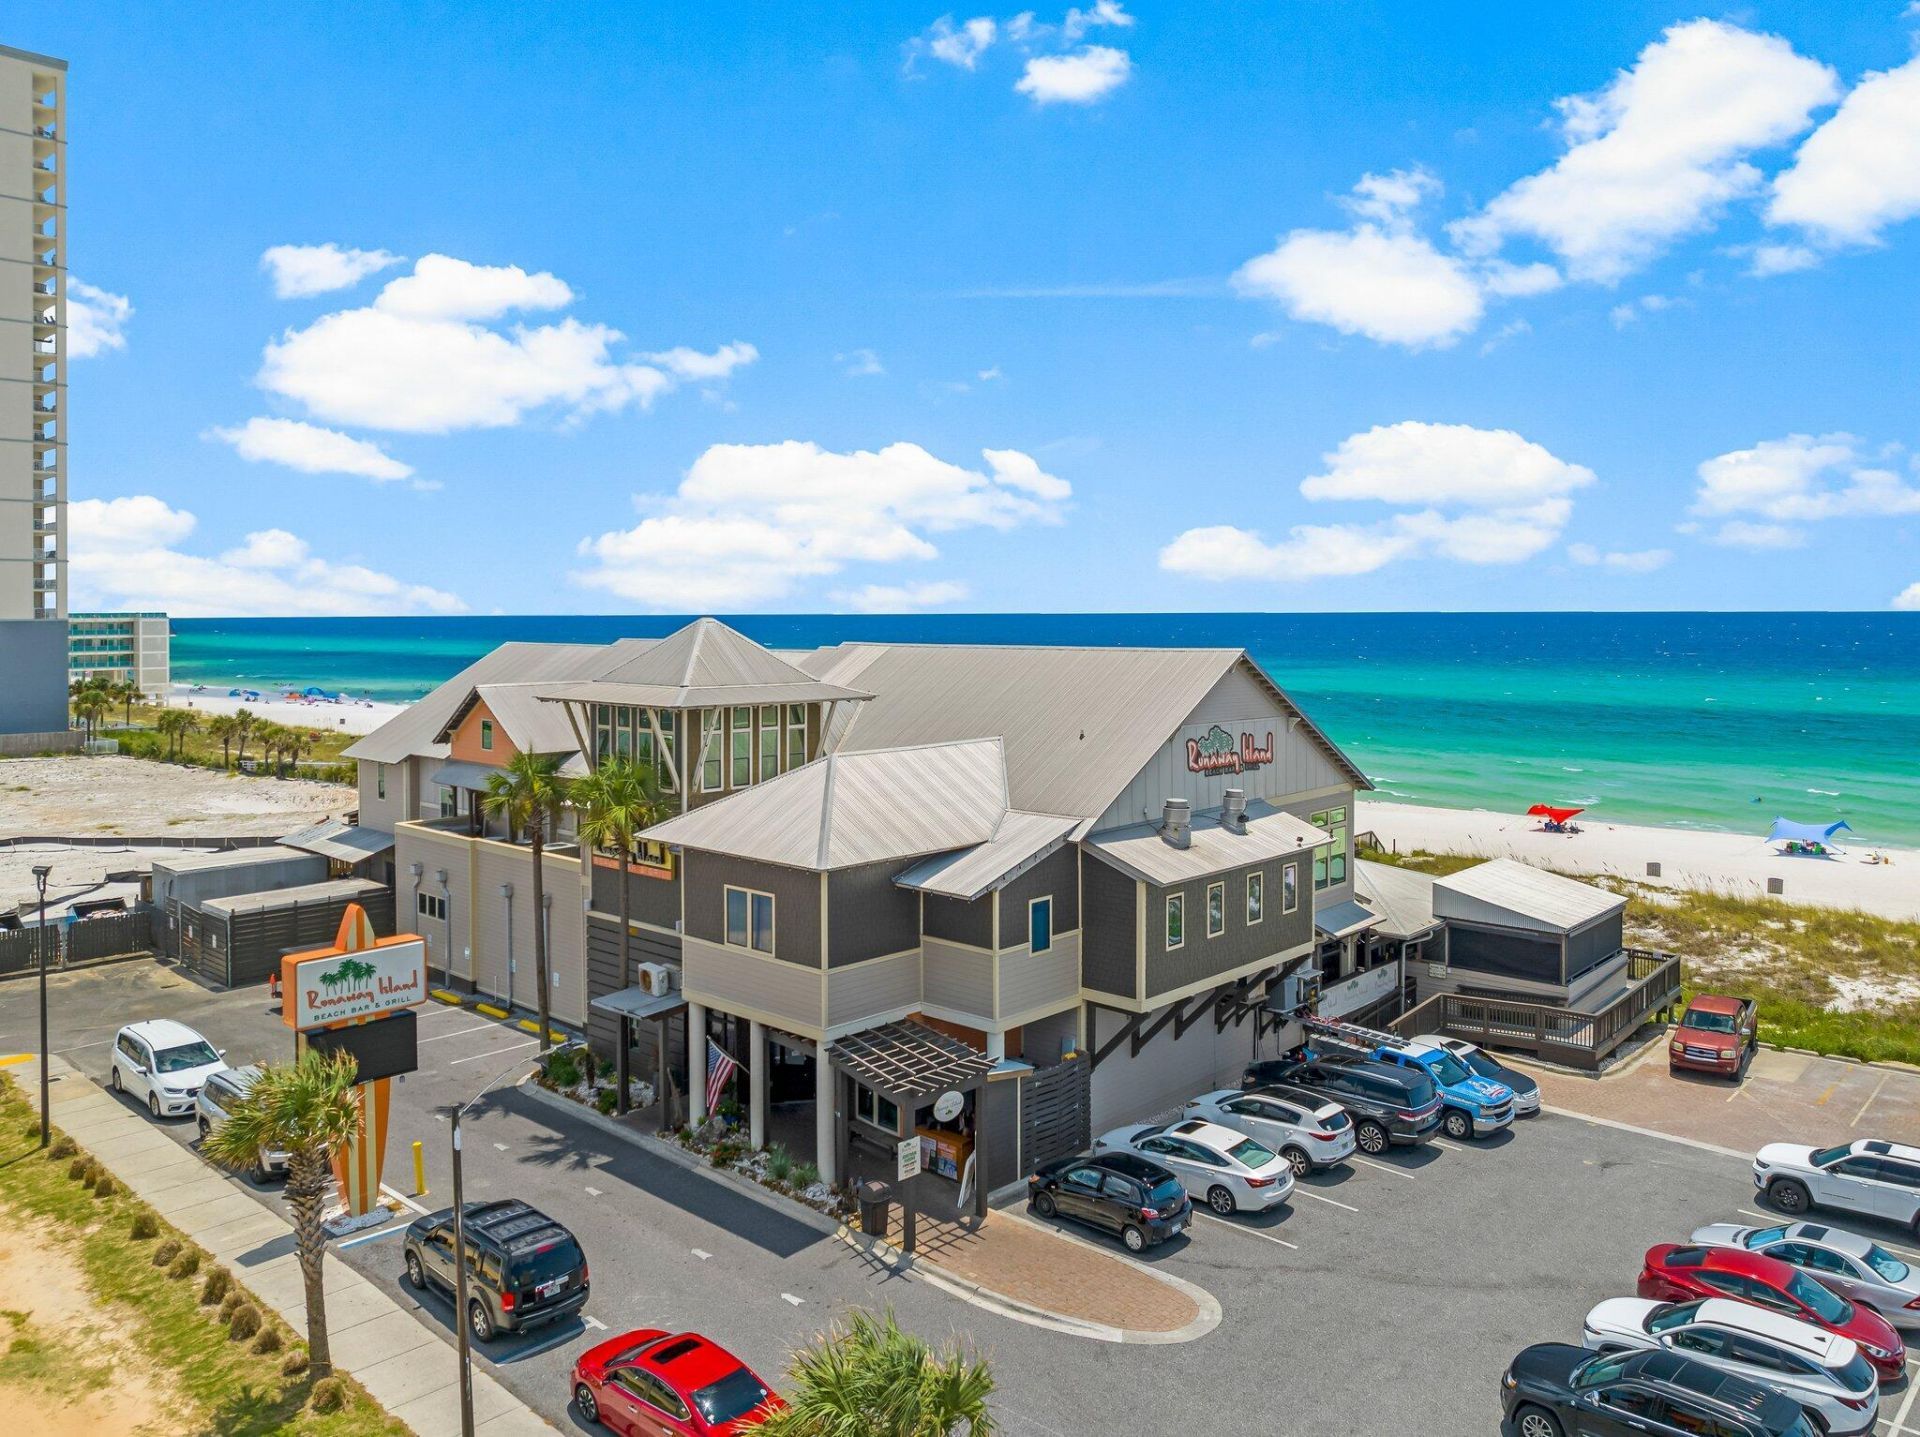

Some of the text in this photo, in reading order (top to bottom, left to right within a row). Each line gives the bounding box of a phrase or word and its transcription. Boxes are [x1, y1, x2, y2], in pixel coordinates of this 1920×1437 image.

[1186, 731, 1274, 775] Runaway Island
[306, 969, 418, 1010] Runaway Island
[314, 1010, 346, 1021] BEACH
[351, 1004, 370, 1014] BAR
[385, 996, 412, 1007] GRILL
